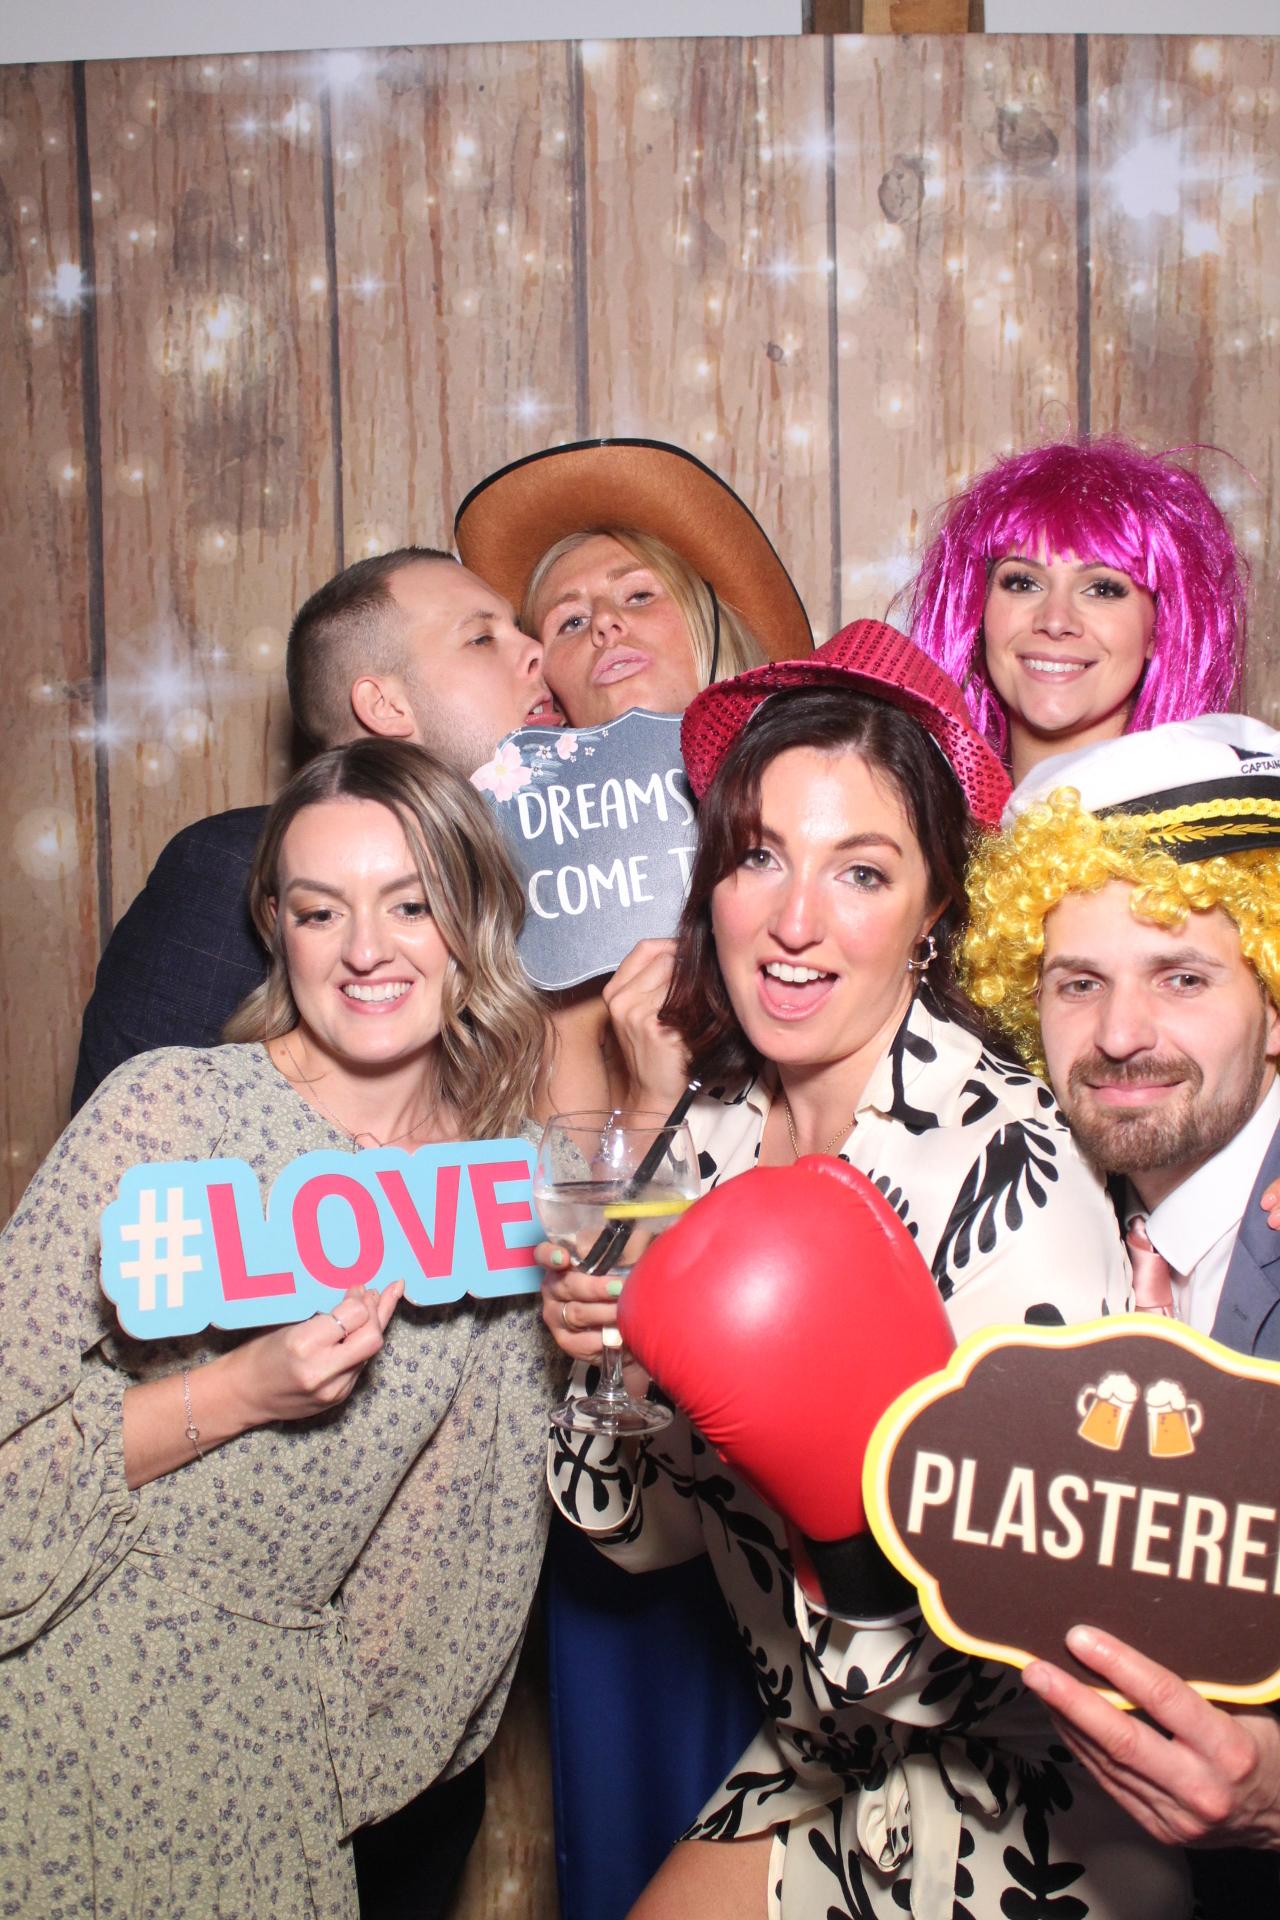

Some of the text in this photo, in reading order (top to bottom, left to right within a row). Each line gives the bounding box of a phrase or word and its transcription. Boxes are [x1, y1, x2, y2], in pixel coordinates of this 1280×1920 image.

[518, 768, 695, 845] DREAMS
[528, 855, 654, 918] COME
[120, 1160, 537, 1311] #LOVE
[907, 1451, 1280, 1596] PLASTERE
